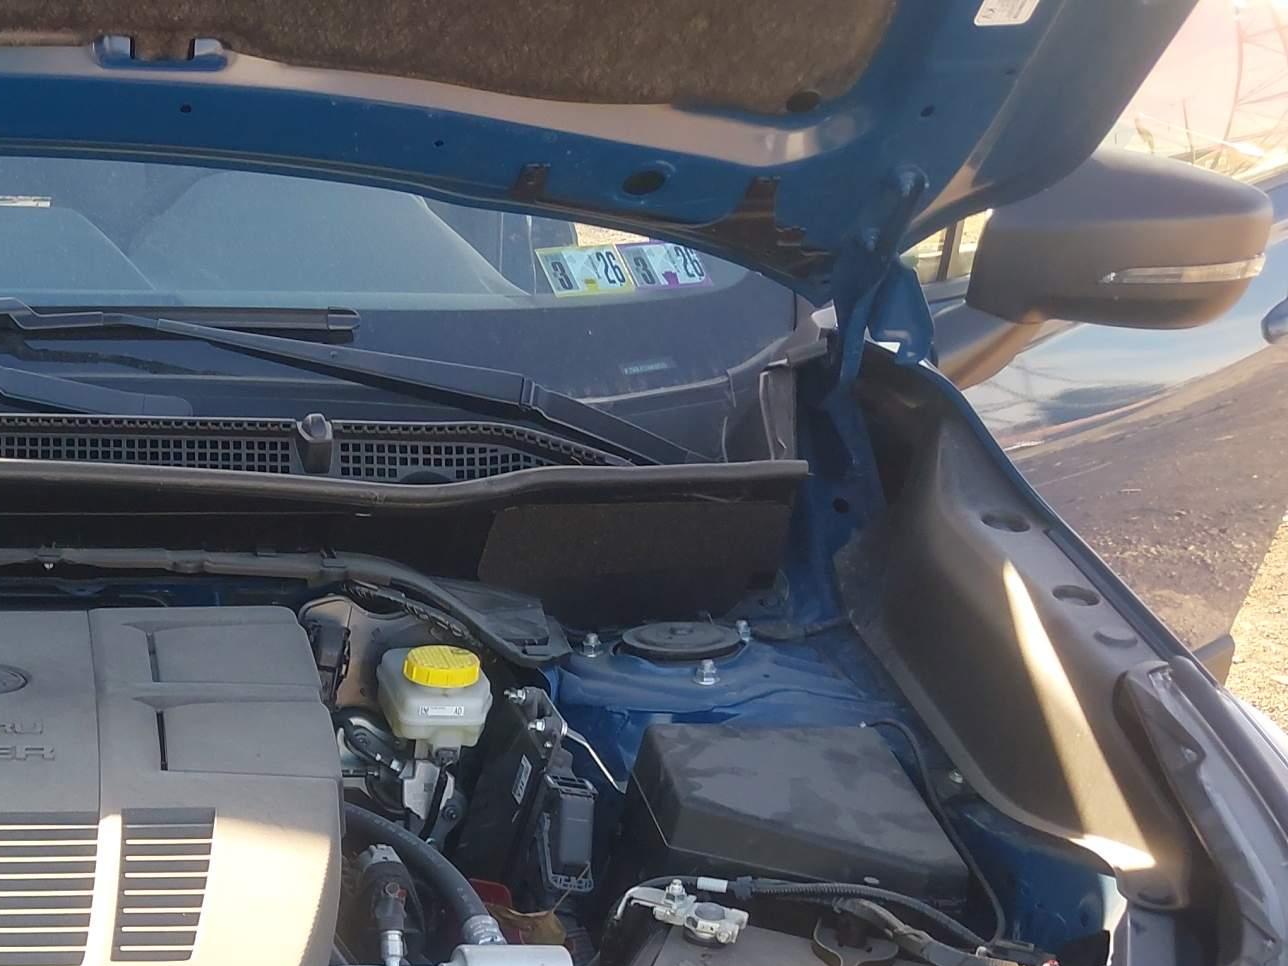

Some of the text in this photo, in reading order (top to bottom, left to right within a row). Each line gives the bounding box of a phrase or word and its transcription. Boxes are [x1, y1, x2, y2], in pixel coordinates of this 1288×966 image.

[551, 251, 626, 290] 3 26
[633, 246, 705, 285] 3 26
